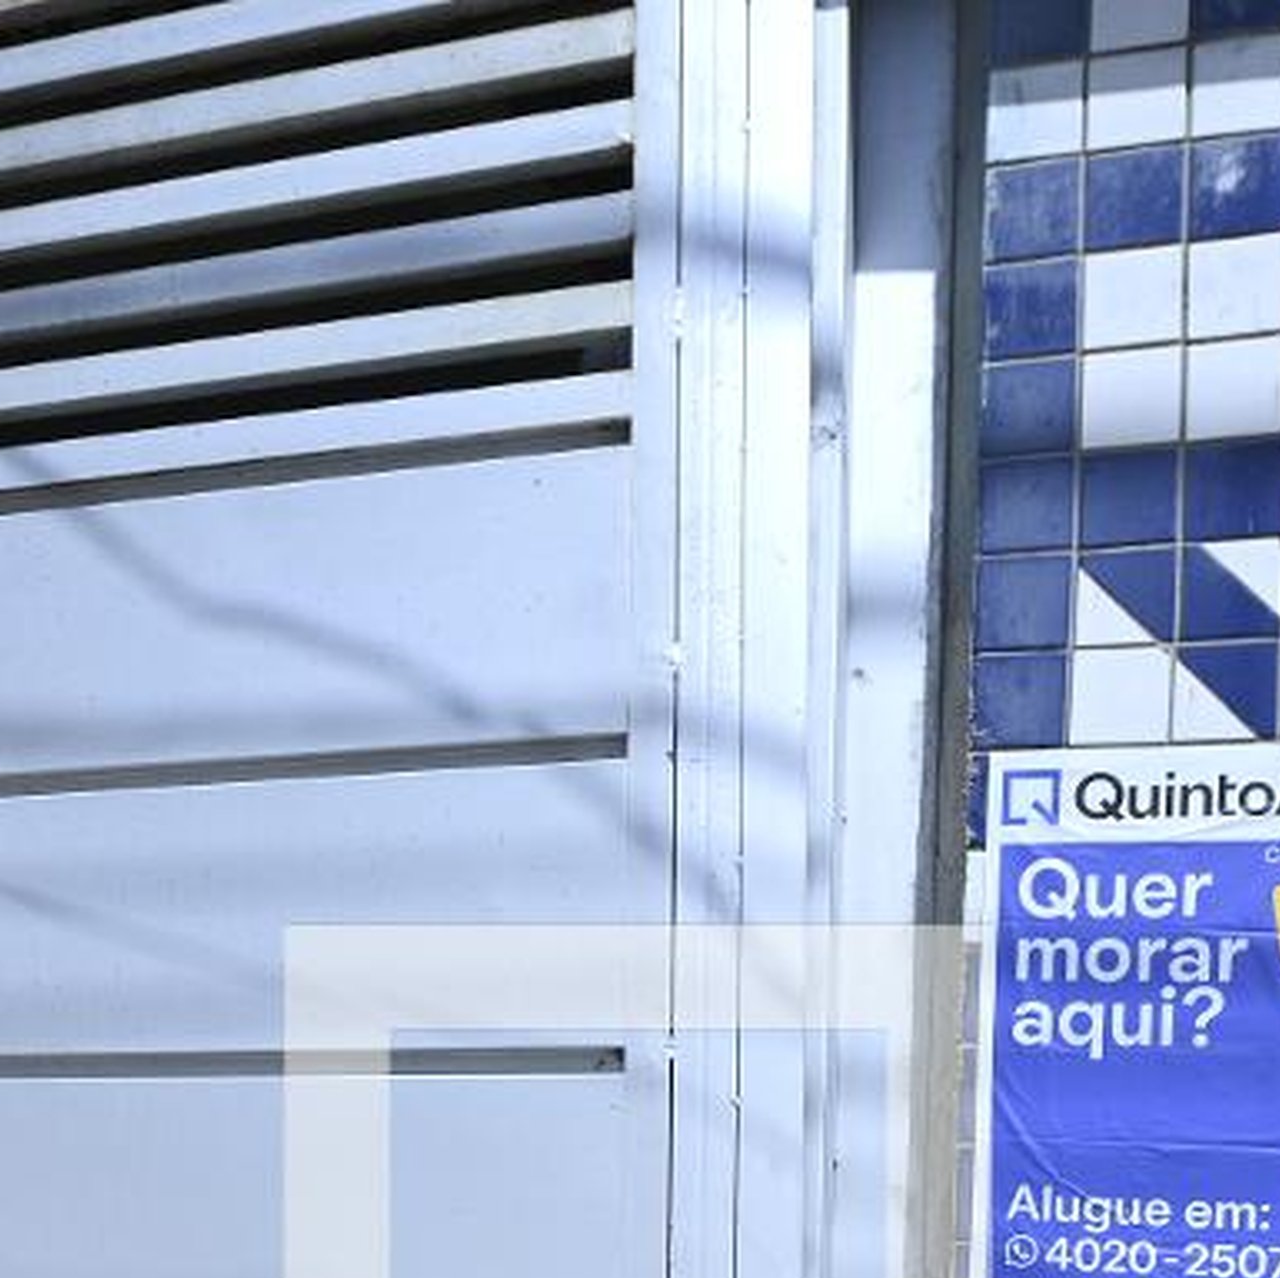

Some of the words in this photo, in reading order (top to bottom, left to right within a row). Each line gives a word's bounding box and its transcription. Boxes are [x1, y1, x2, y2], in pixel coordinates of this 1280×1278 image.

[1018, 857, 1214, 919] Quer
[1016, 933, 1248, 983] morar
[1011, 986, 1224, 1060] aqui?
[1007, 1184, 1171, 1230] Alugue
[1184, 1197, 1272, 1231] em:
